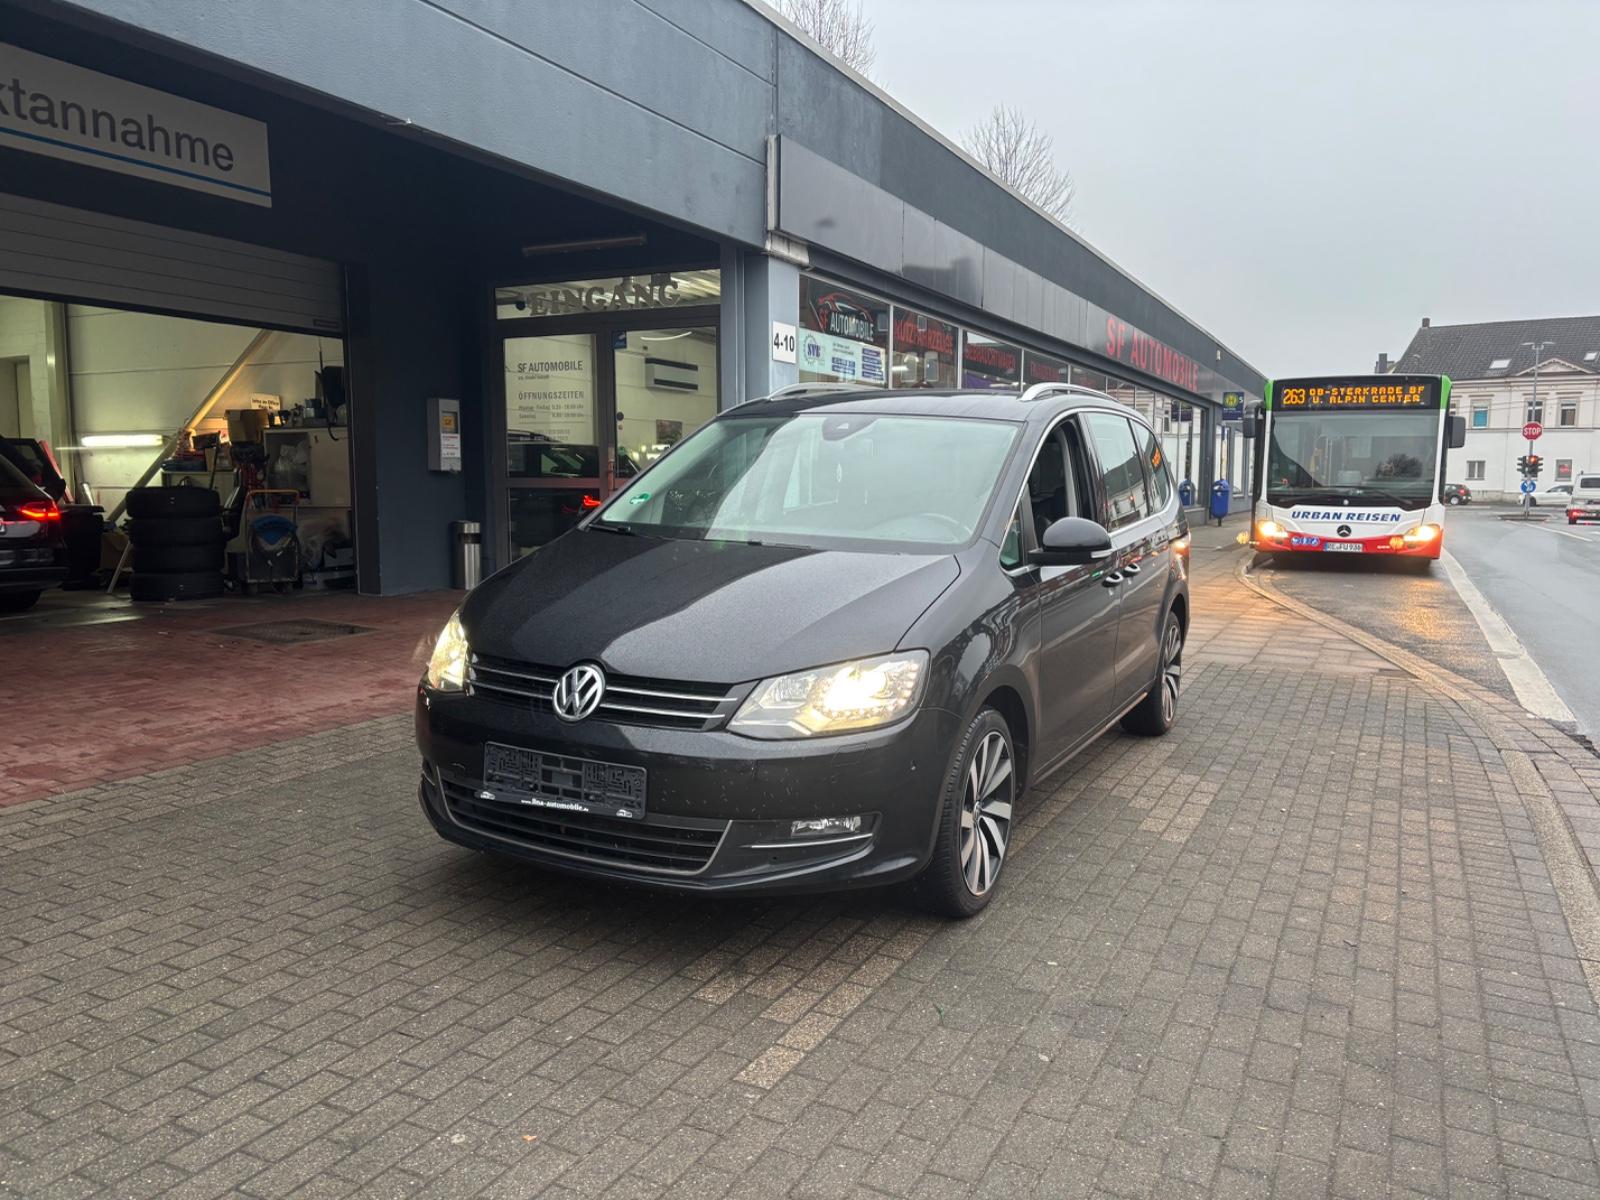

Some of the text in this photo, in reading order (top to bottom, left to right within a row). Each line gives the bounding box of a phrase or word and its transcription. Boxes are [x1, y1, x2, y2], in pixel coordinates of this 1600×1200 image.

[530, 281, 680, 315] EINGANG
[830, 311, 874, 342] AUTOMOBILE
[773, 332, 795, 352] 4-10
[1106, 318, 1197, 392] SF AUTOMOBILE
[518, 361, 584, 373] SF AUTOMOBILE
[518, 390, 585, 400] ÖFFNUNGSZEITEN
[1283, 388, 1305, 405] 263
[1329, 395, 1366, 403] ALPIN
[1372, 394, 1421, 403] CENTER
[1523, 427, 1542, 436] STOP
[1291, 510, 1402, 522] URBAN REISEN
